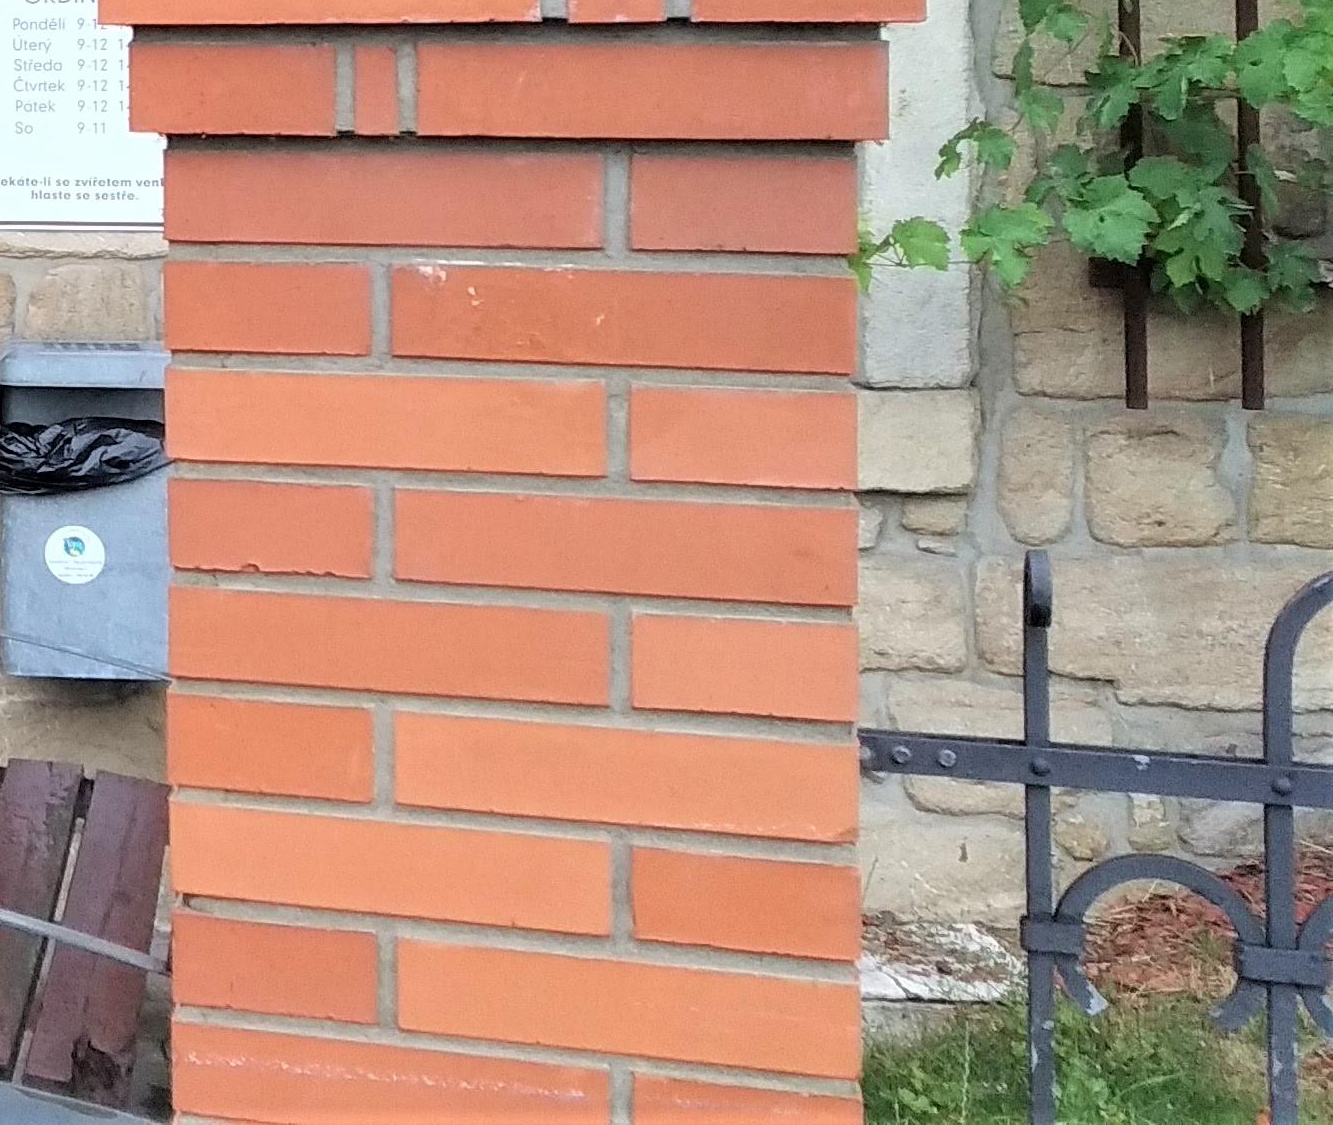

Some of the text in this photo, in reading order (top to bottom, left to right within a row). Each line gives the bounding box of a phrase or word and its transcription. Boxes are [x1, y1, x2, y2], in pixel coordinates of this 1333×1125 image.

[12, 17, 66, 31] Pondělí
[12, 34, 52, 54] Úterý
[77, 38, 108, 51] 9-12
[13, 58, 63, 72] Středa
[77, 58, 108, 72] 9-12
[13, 76, 66, 92] Čtvrtek
[77, 79, 108, 92] 9-12
[15, 99, 56, 113] Pátek
[77, 99, 108, 113] 9-12
[14, 121, 106, 135] So 9-11
[55, 178, 70, 187] se
[74, 176, 132, 187] zvířetem
[30, 189, 139, 200] hlaste se sestře.
